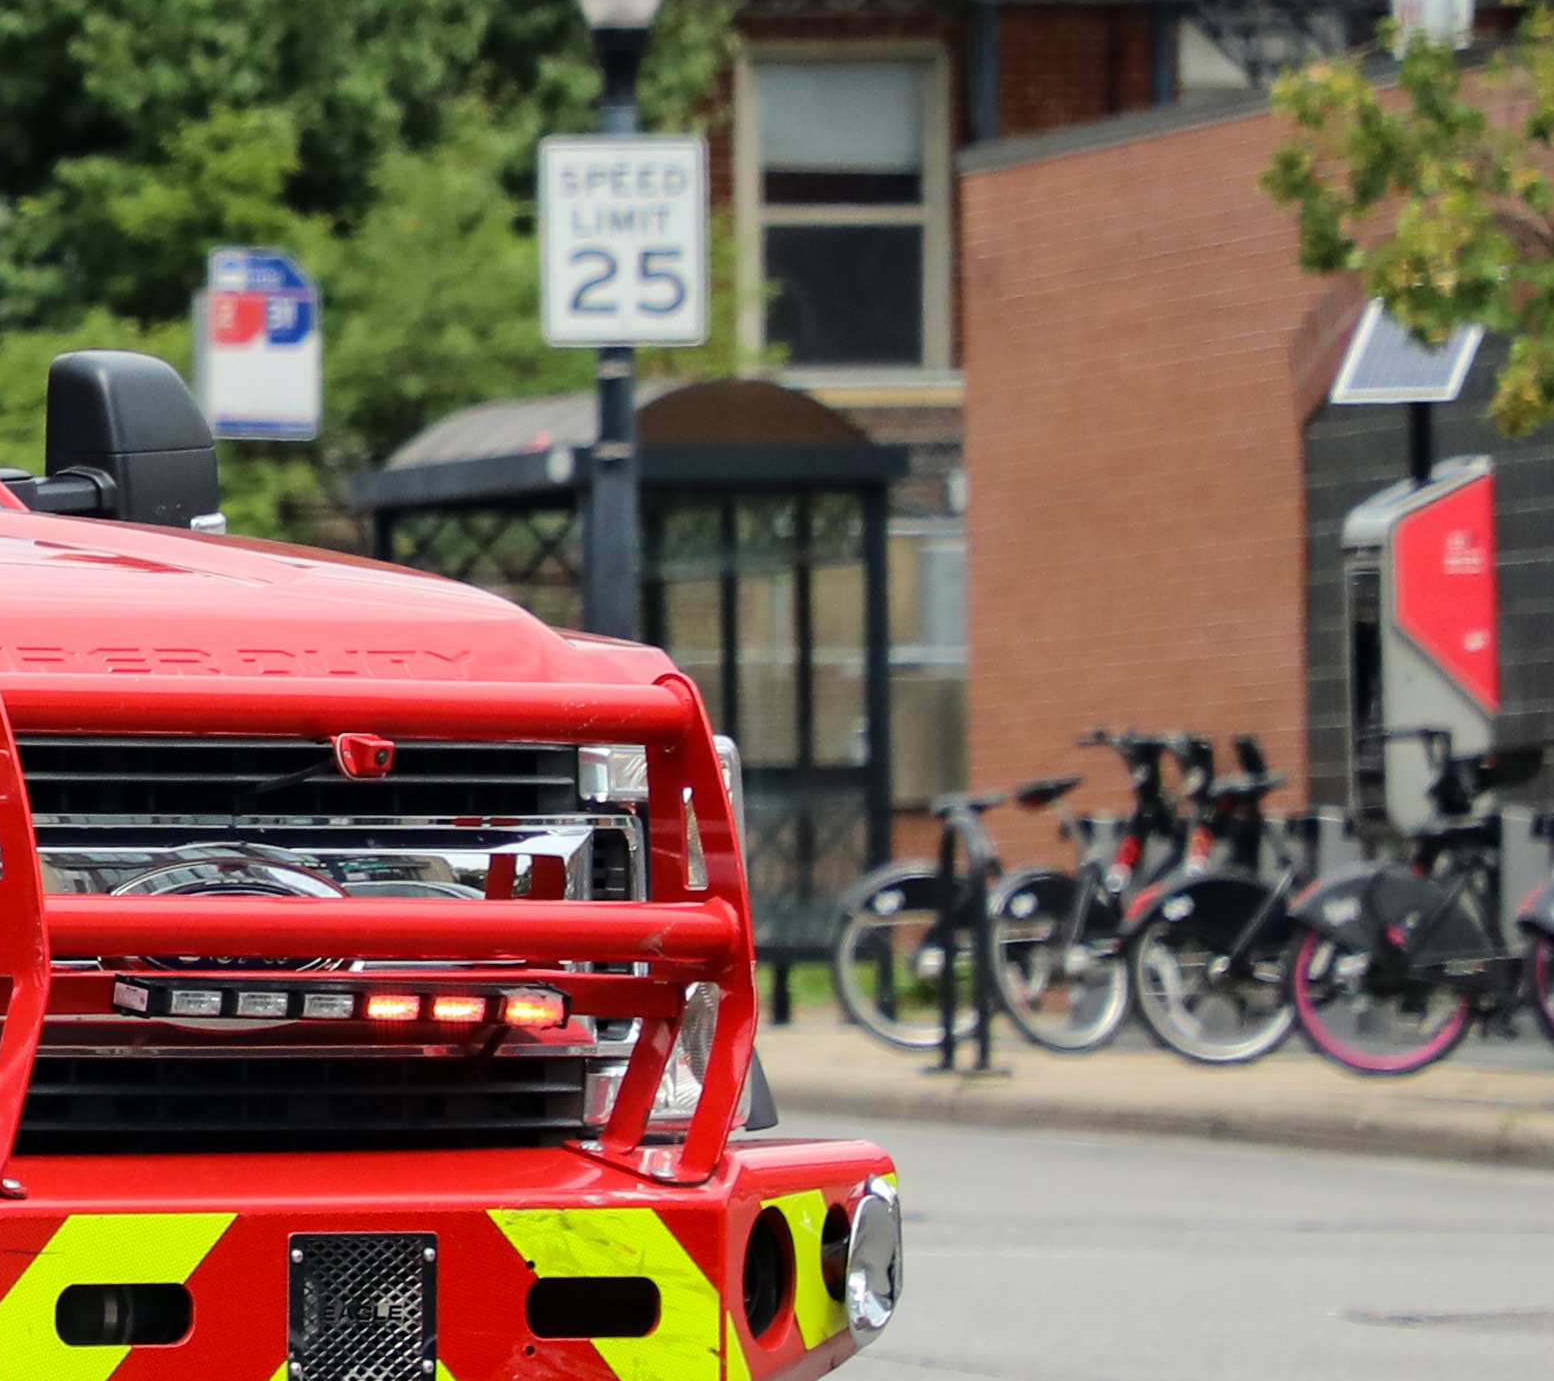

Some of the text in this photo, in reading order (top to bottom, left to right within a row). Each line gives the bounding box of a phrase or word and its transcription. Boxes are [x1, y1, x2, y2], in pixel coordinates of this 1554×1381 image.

[561, 164, 685, 197] SPEED
[572, 207, 670, 236] LIMIT
[570, 248, 685, 314] 25
[237, 648, 473, 679] DUTY
[323, 1305, 403, 1321] EAGLE
